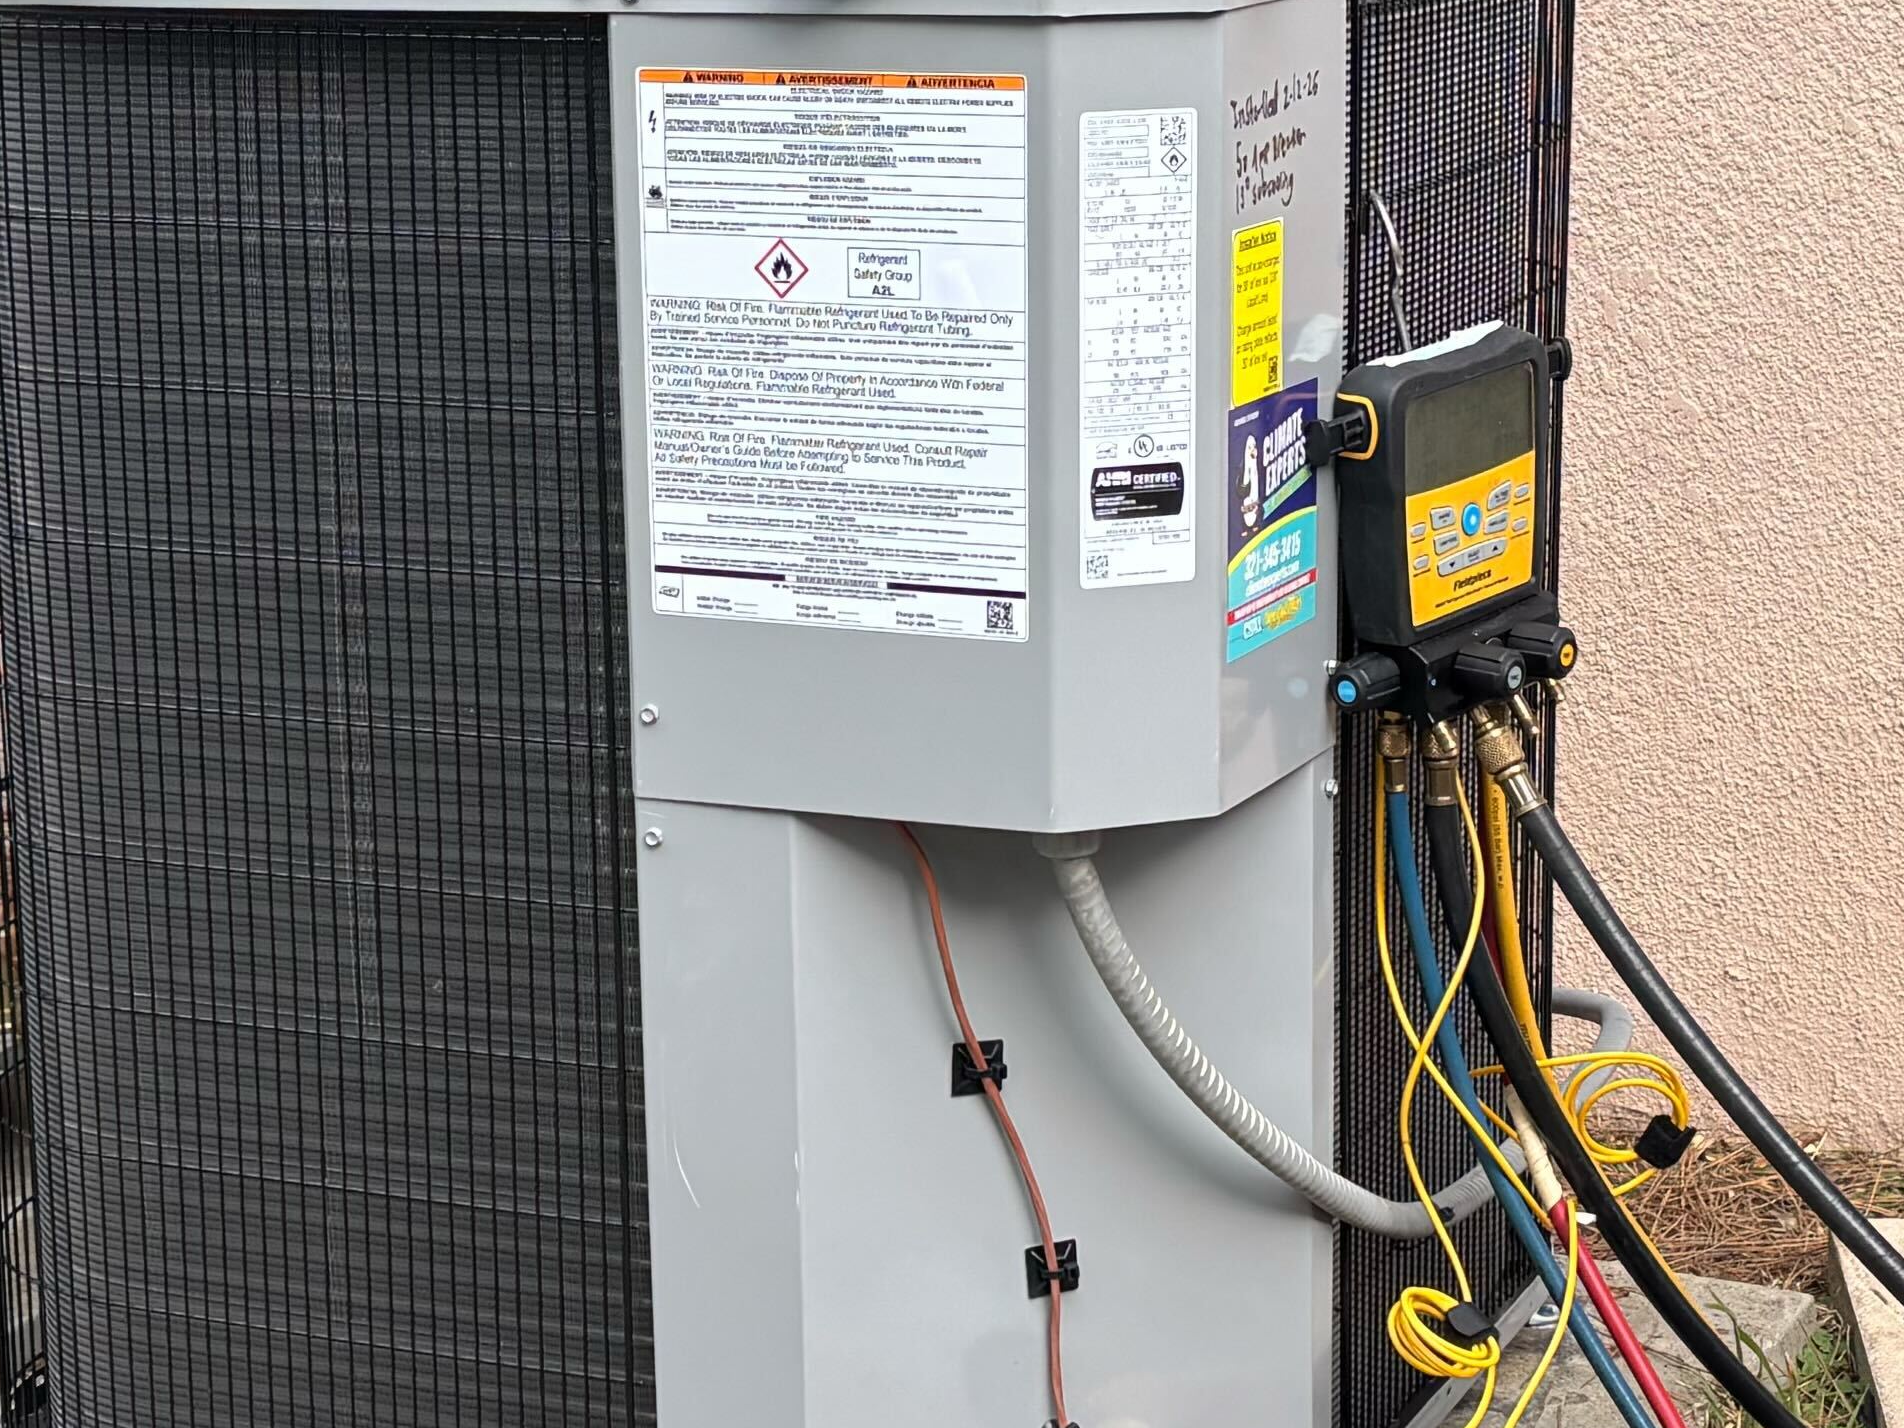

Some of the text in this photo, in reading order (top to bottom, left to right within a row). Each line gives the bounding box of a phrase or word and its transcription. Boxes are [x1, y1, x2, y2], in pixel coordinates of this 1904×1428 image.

[696, 73, 995, 89] WARNING AVERTISSEMENT ADVERTENCIA
[858, 252, 908, 266] Refrigerant
[854, 268, 912, 283] Safety Group
[872, 285, 895, 296] A2L
[650, 311, 663, 324] By
[666, 312, 700, 323] Trained
[704, 314, 739, 325] Service
[796, 318, 809, 328] Do
[813, 319, 829, 329] Not
[833, 319, 876, 331] Puncture
[879, 321, 934, 335] Refrigerant
[706, 301, 726, 312] Risk
[730, 302, 742, 313] Of
[769, 304, 822, 316] Flammable
[825, 306, 879, 321] Refrigerant
[882, 309, 907, 320] Used
[911, 310, 922, 320] To
[925, 311, 939, 322] Be
[941, 312, 986, 326] Repaired
[990, 313, 1014, 328] Only
[653, 375, 664, 385] Or
[667, 376, 692, 387] Local
[756, 381, 809, 394] Flammable
[812, 383, 865, 399] Refrigerant
[708, 366, 728, 376] Risk
[732, 367, 743, 377] Of
[770, 370, 808, 383] Dispose
[812, 371, 823, 381] Of
[870, 375, 877, 384] In
[880, 376, 938, 388] Accordance
[941, 379, 963, 389] With
[967, 379, 1004, 391] Federal
[710, 431, 729, 442] Risk
[733, 432, 744, 443] Of
[771, 436, 824, 448] Flammable
[827, 438, 880, 454] Refrigerant
[914, 444, 952, 455] Consult
[955, 445, 988, 459] Repair
[1263, 407, 1303, 467] CLIMATE
[669, 454, 698, 468] Safety
[701, 456, 756, 468] Precautions
[760, 458, 782, 470] Must
[733, 445, 761, 457] Guide
[763, 447, 795, 459] Before
[864, 453, 899, 465] Service
[903, 454, 923, 466] This
[1266, 436, 1306, 496] EXPERTS
[1453, 569, 1492, 592] Fieldpiece
